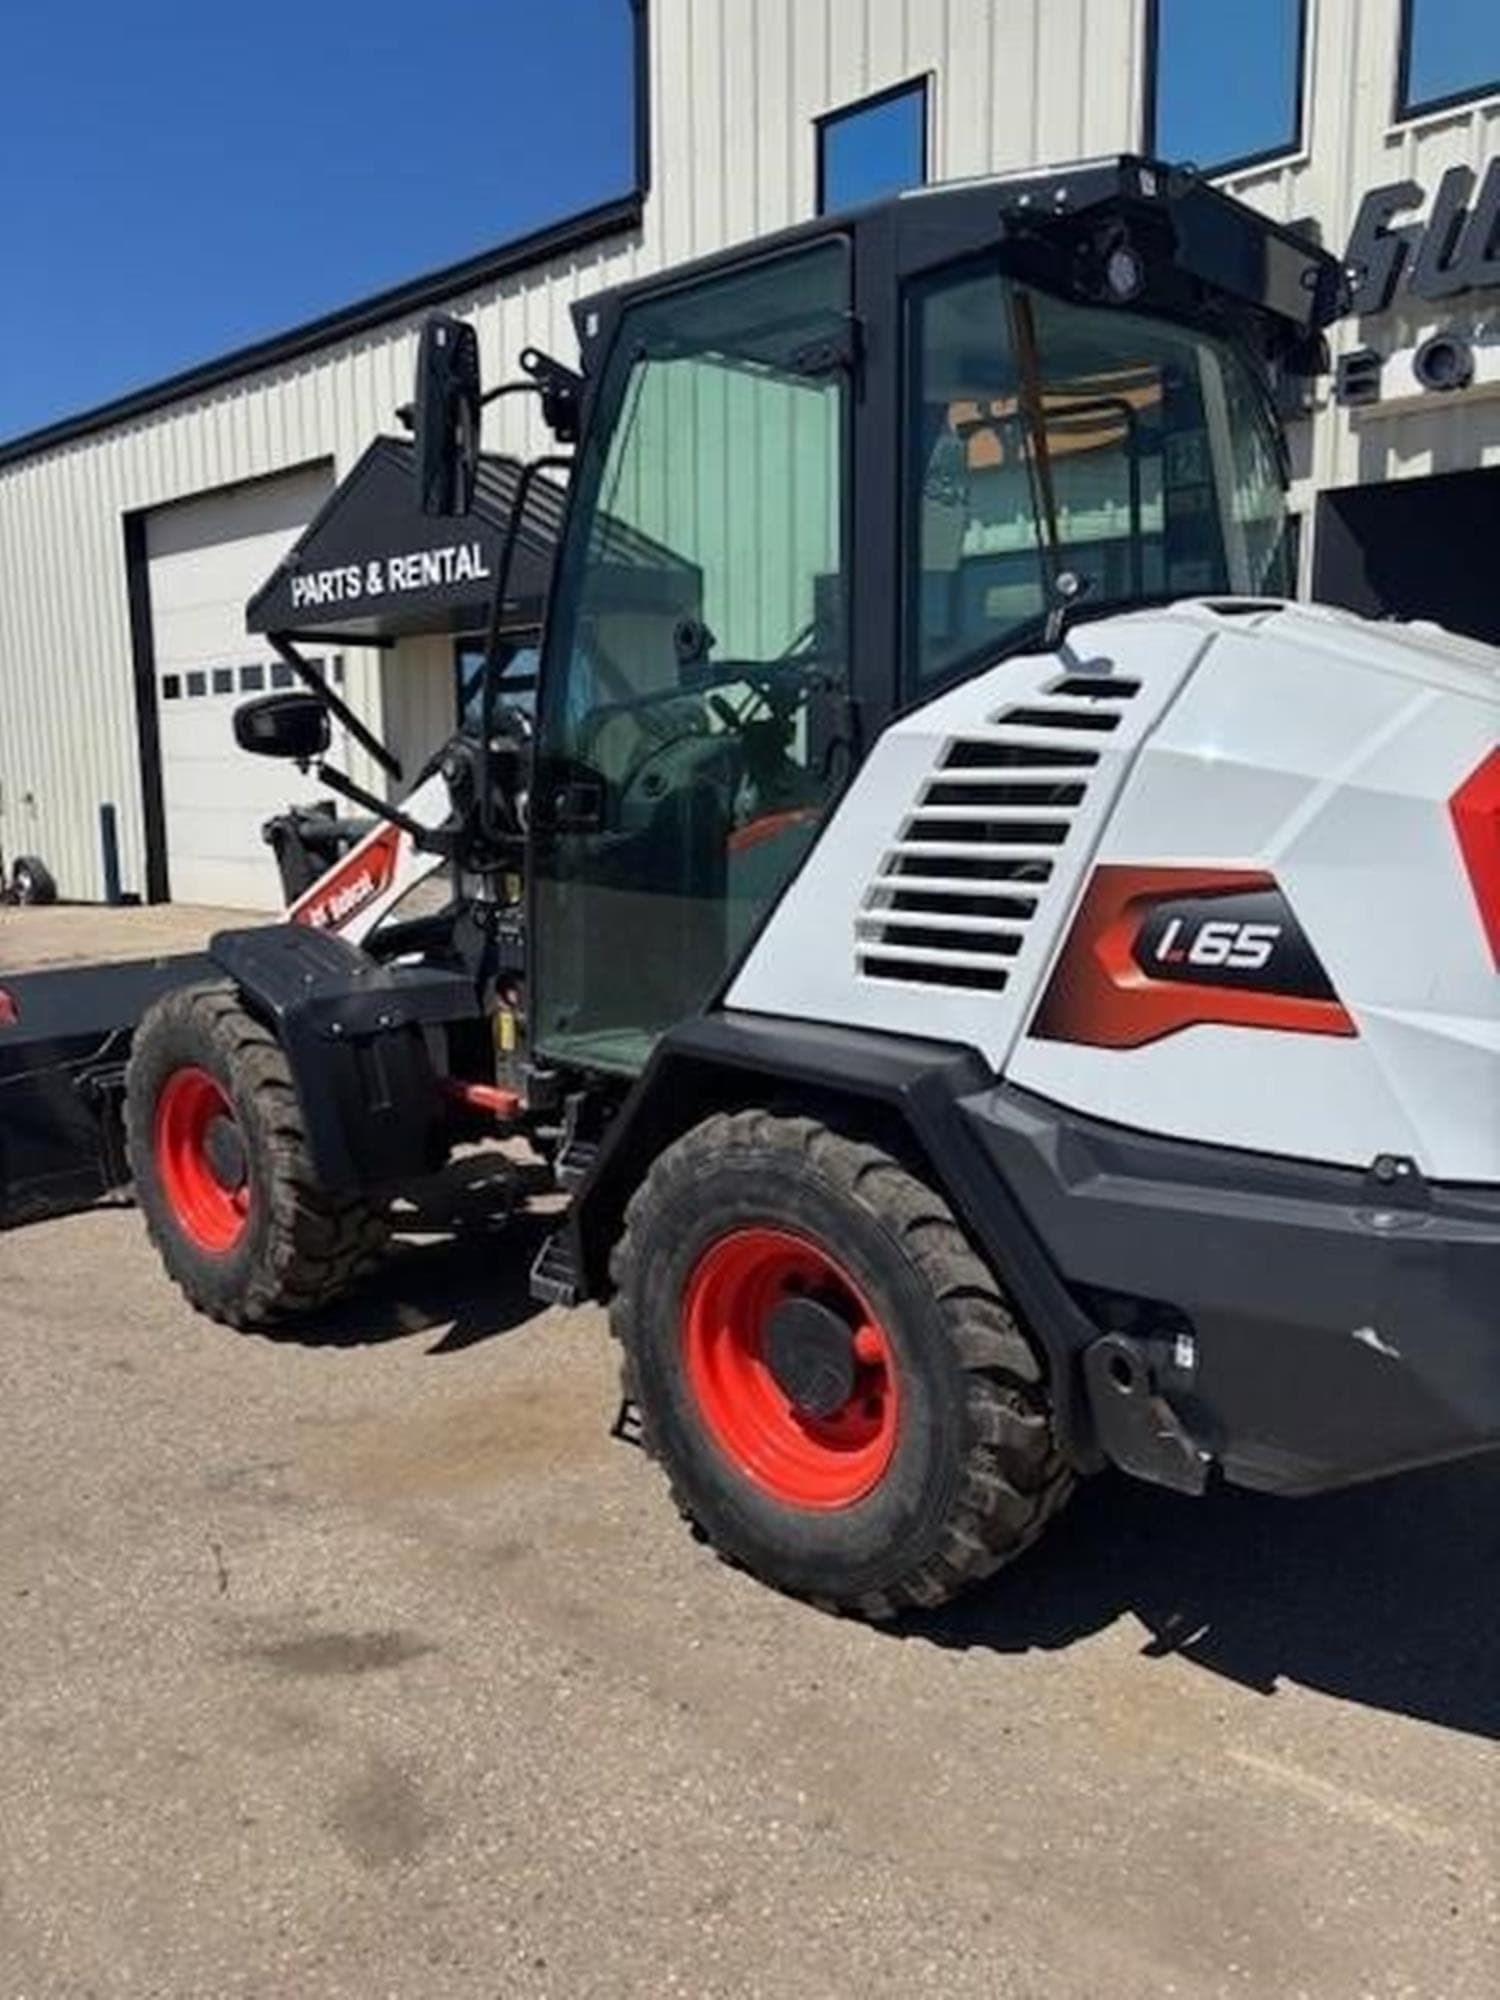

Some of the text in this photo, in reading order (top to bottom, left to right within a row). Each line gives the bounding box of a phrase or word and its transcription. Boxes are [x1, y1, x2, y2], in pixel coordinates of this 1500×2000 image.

[291, 543, 490, 608] PARTS & RENTAL
[1156, 918, 1281, 968] L65
